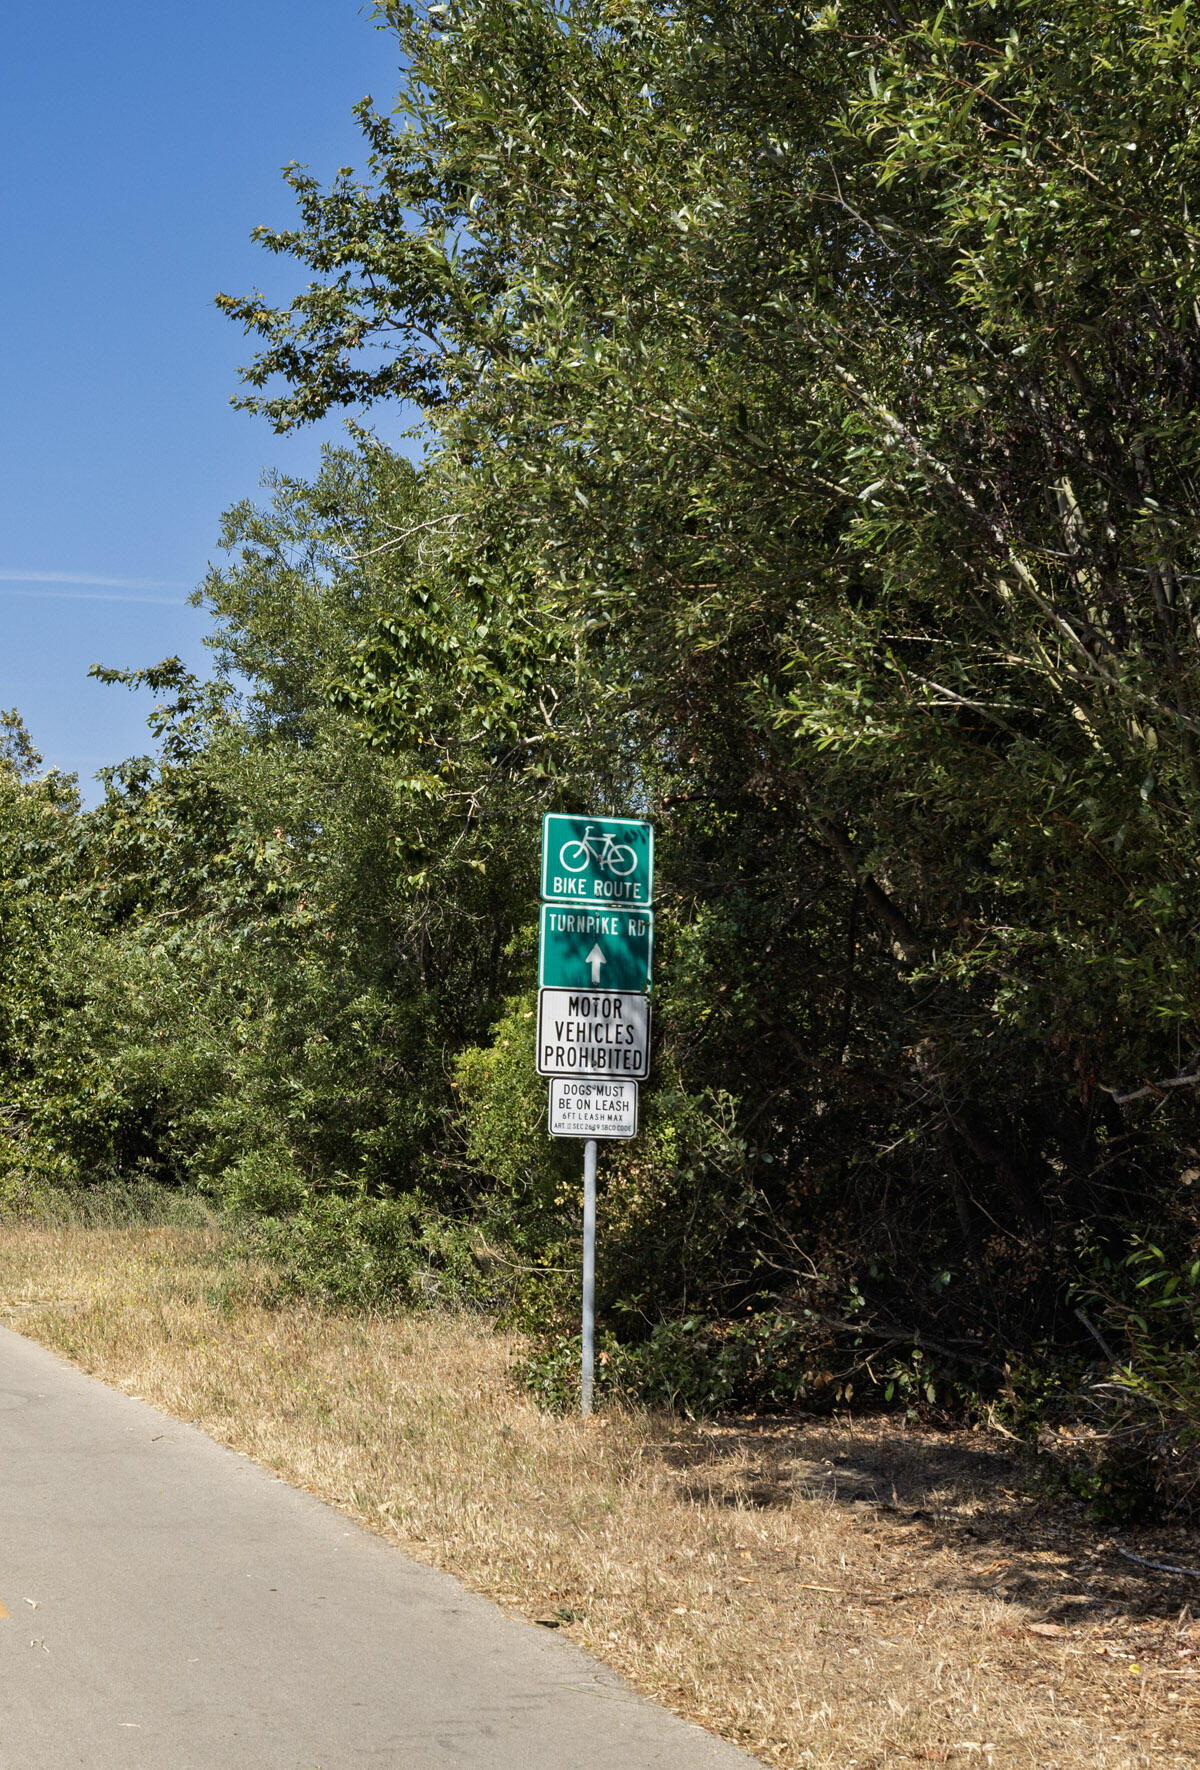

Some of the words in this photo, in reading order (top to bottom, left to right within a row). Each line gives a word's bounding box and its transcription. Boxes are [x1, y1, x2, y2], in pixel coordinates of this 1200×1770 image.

[553, 876, 587, 895] BIKE
[593, 880, 642, 899] ROUTE
[549, 913, 619, 935] TURNPIKE
[628, 919, 646, 936] RD
[568, 996, 622, 1019] MOTOR
[555, 1021, 634, 1045] VEHICLES
[544, 1046, 642, 1070] PROHIBITED
[563, 1084, 592, 1096] DOGS
[596, 1085, 625, 1097] MUST
[558, 1098, 572, 1109] BE
[576, 1099, 591, 1110] ON
[596, 1100, 629, 1111] LEASH
[578, 1113, 605, 1121] LEASH
[607, 1114, 623, 1122] MAX
